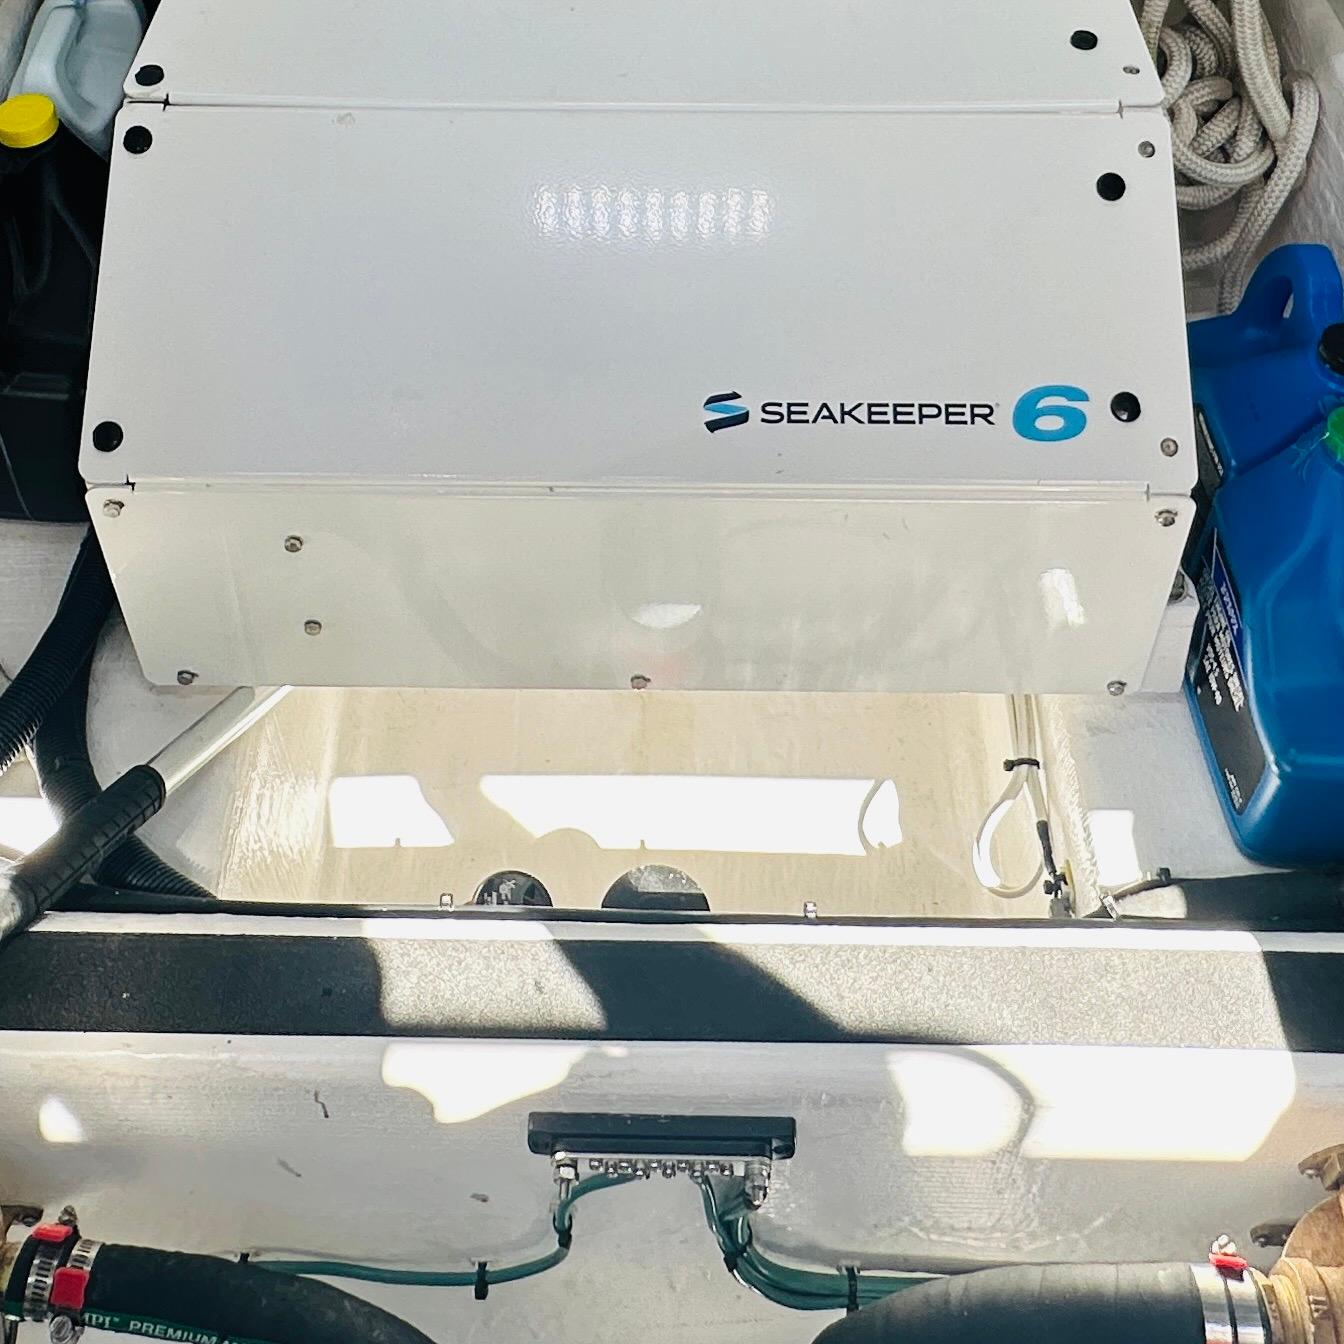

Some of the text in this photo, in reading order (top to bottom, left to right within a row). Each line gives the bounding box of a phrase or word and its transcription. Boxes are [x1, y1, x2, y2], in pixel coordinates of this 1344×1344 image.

[760, 384, 1090, 442] SEAKEEPER 6
[129, 1320, 218, 1344] PREMIUM
